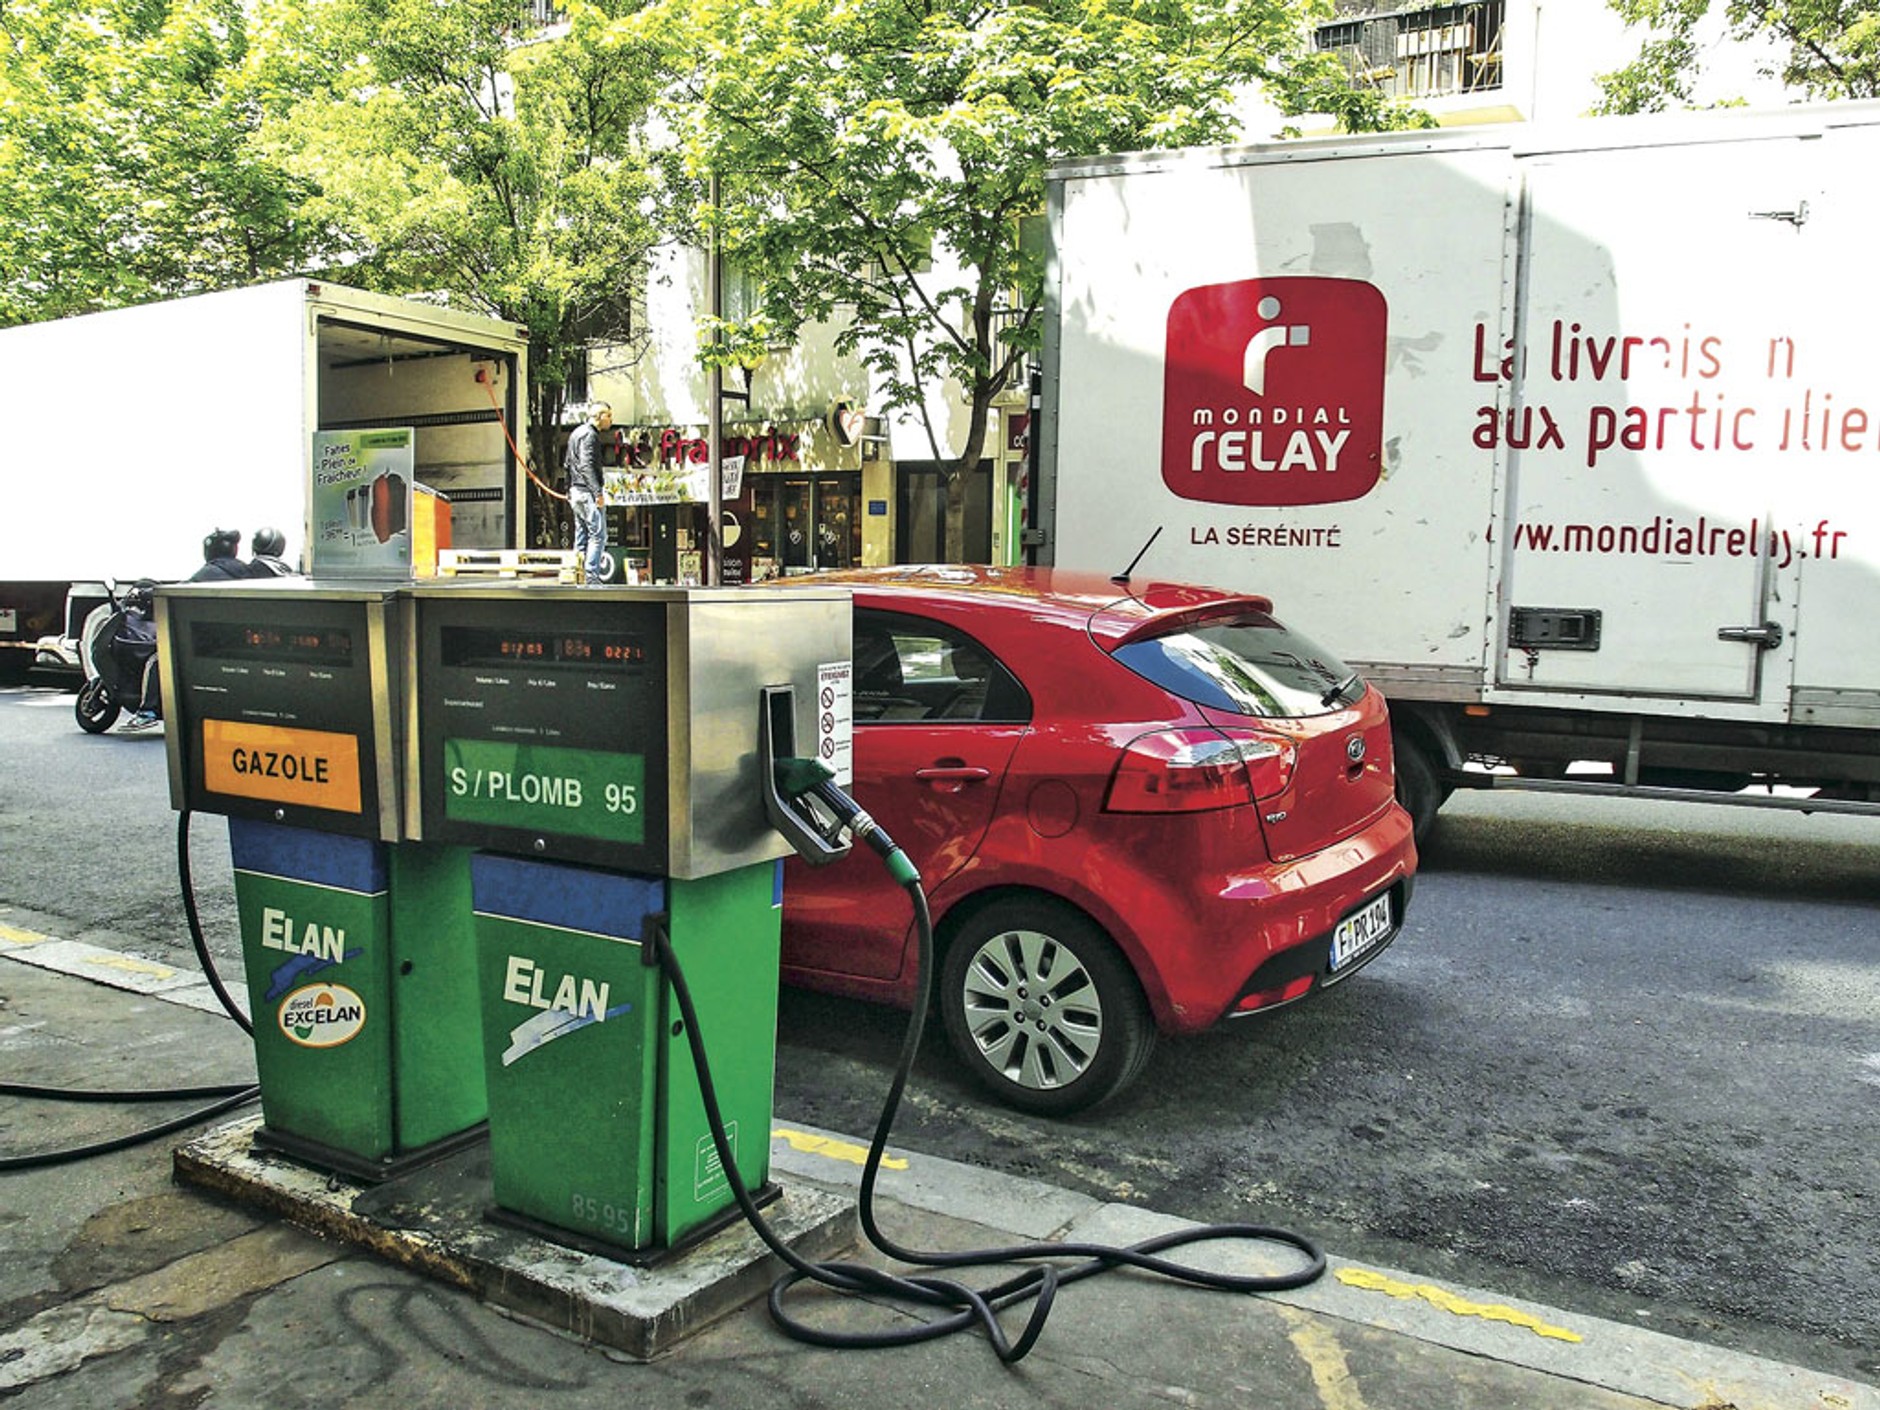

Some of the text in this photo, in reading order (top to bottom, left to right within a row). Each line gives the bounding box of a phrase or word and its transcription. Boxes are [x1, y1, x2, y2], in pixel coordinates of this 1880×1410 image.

[1192, 407, 1351, 425] MONDIAL
[1473, 405, 1565, 451] aux
[1190, 522, 1342, 548] LA SÉRÉNITÉ
[232, 748, 329, 784] GAZOLE
[605, 782, 637, 815] 95
[262, 906, 345, 965] ELAN
[503, 955, 610, 1023] ELAN
[284, 1005, 361, 1028] EXCELAN
